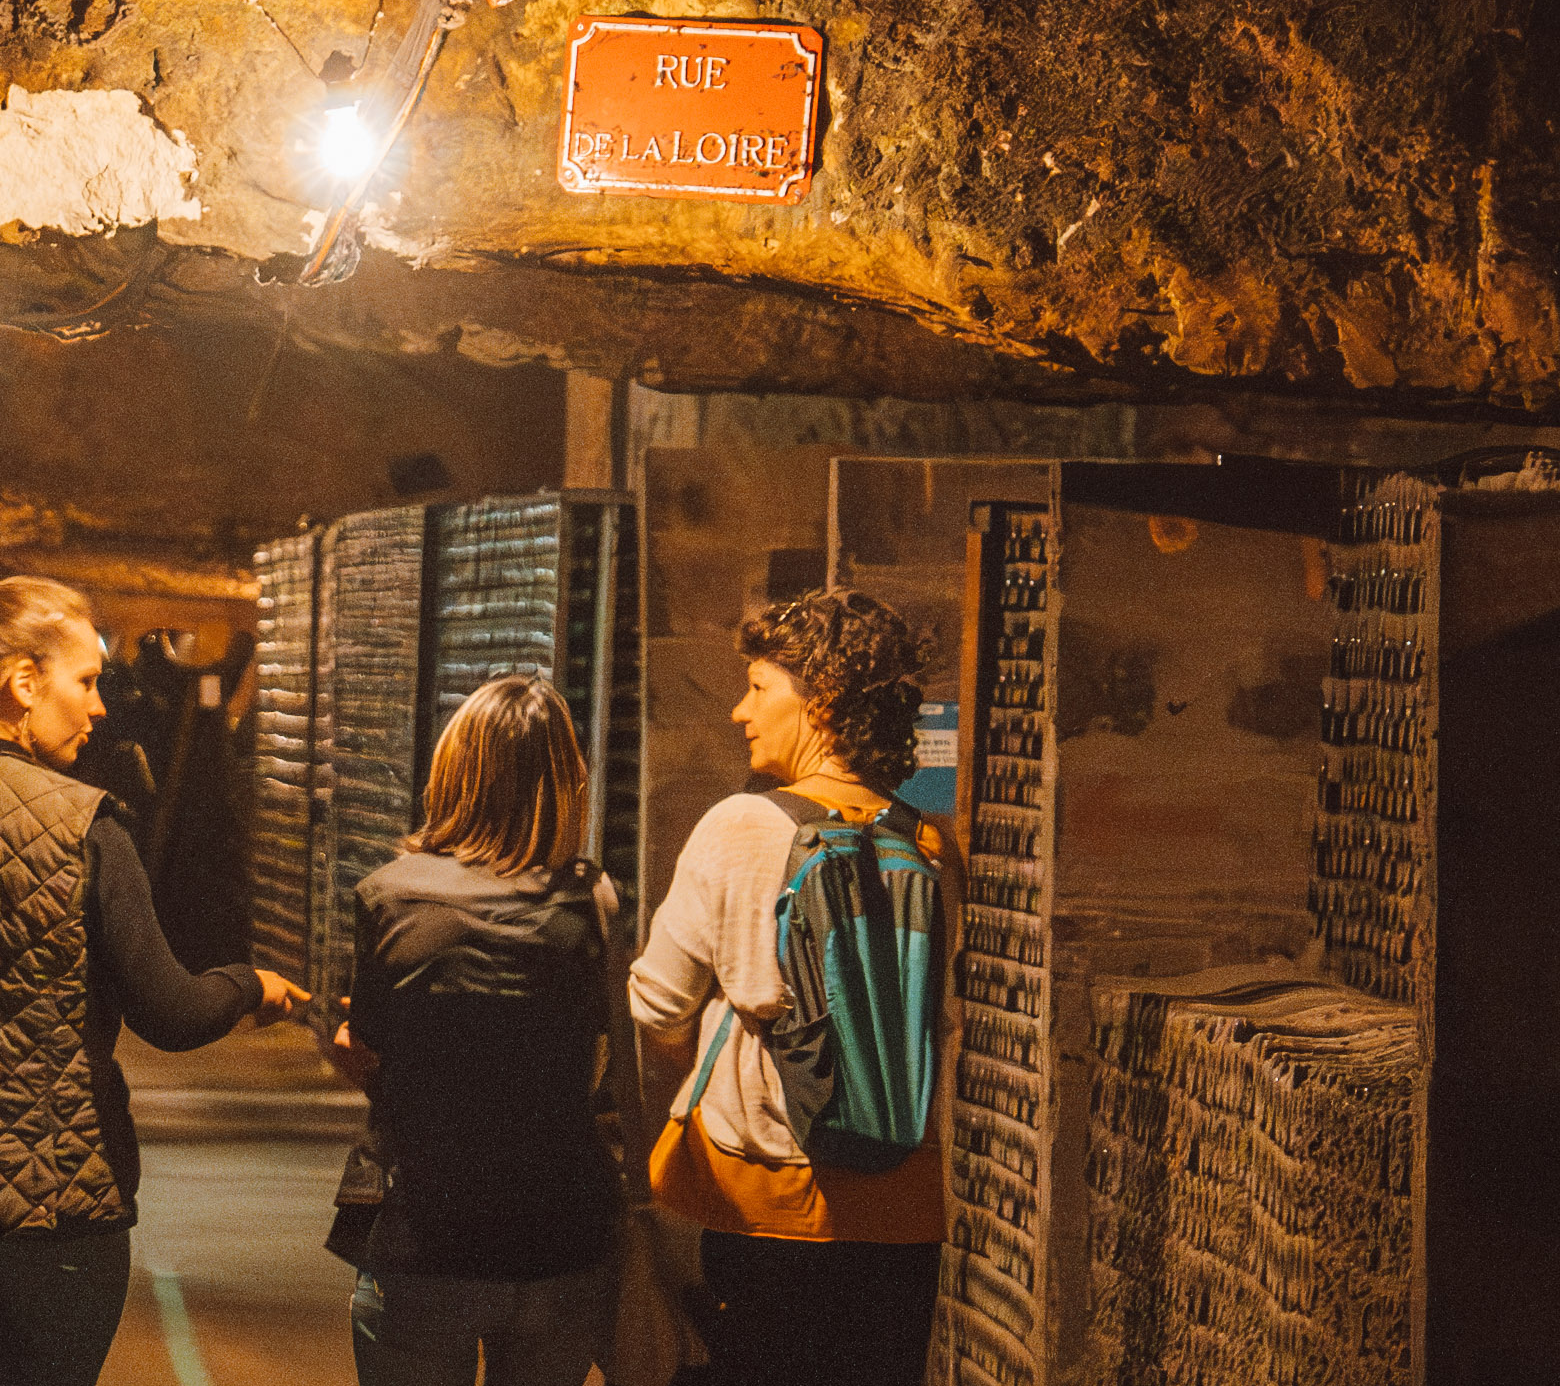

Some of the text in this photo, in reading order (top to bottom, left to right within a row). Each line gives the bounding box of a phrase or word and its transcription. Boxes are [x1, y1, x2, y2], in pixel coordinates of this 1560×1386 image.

[655, 54, 729, 90] RUE
[574, 130, 790, 169] DE LA LOIRE
